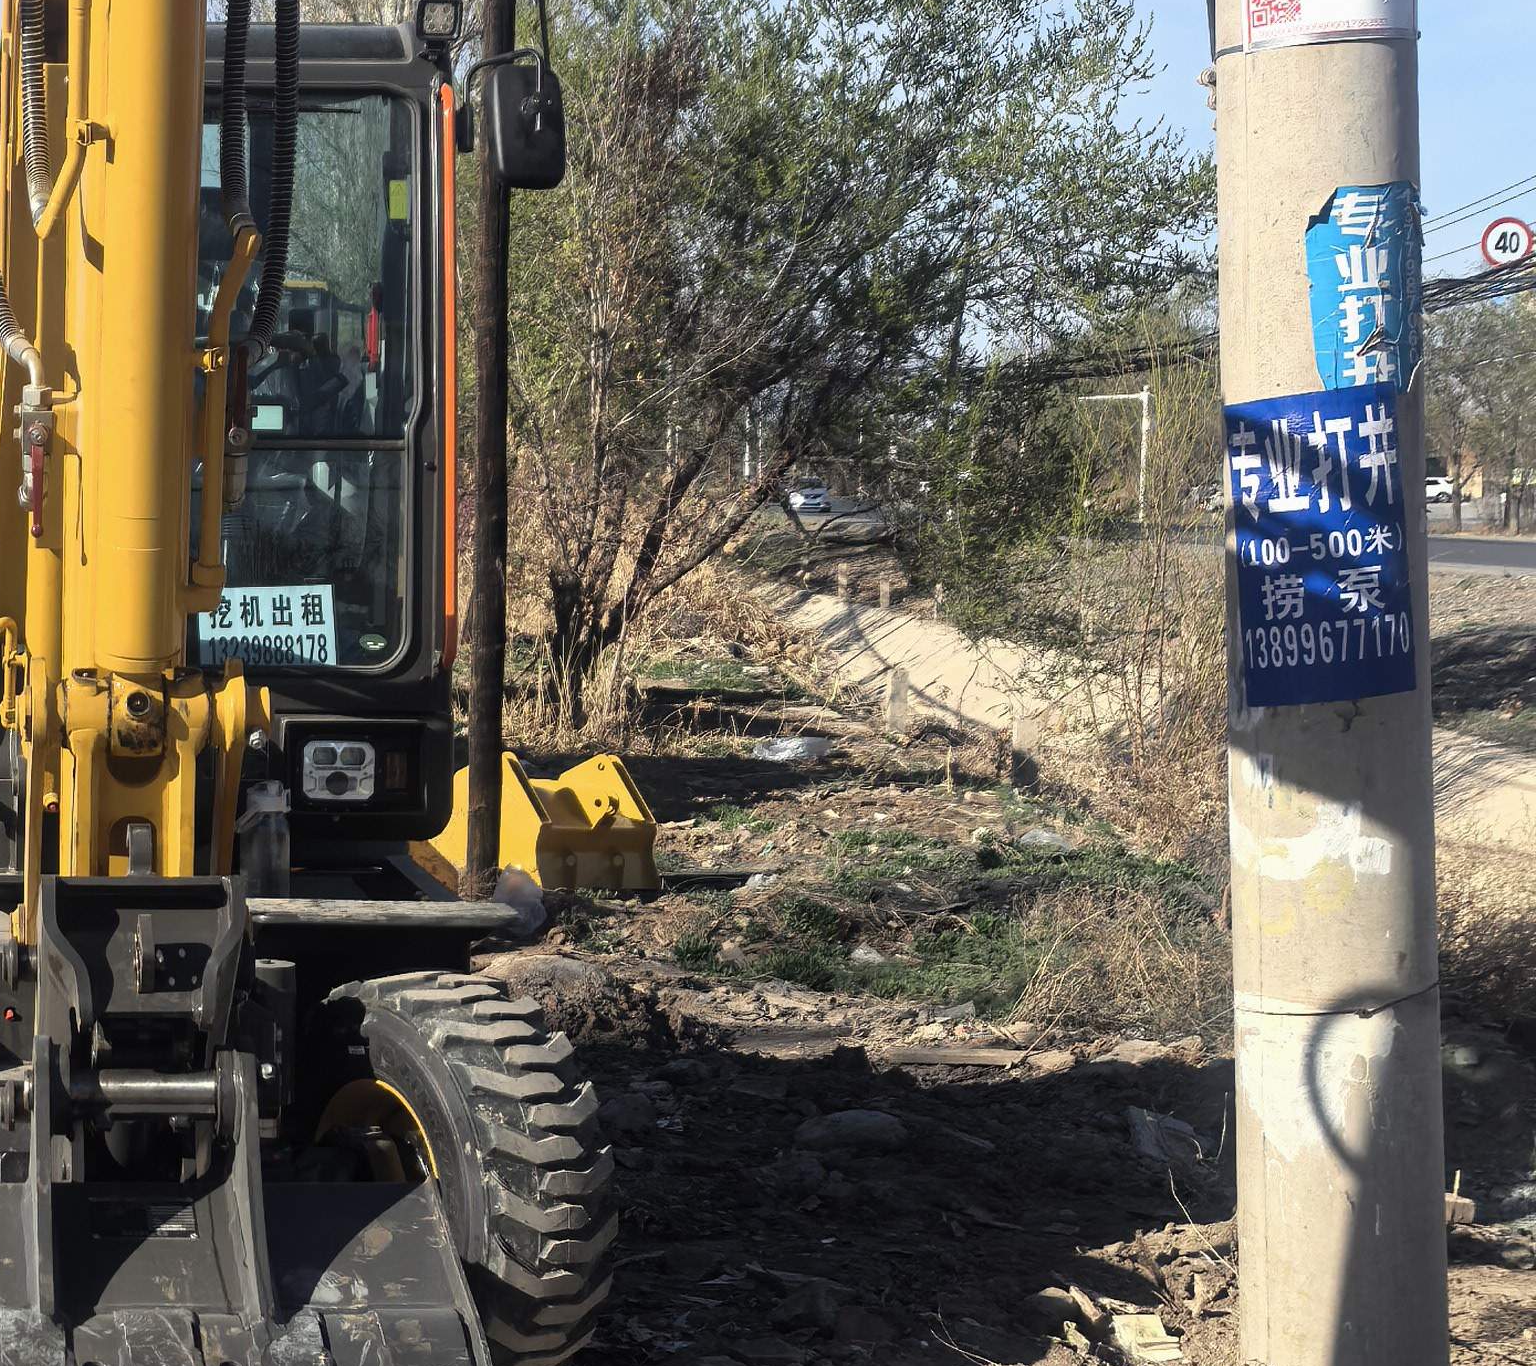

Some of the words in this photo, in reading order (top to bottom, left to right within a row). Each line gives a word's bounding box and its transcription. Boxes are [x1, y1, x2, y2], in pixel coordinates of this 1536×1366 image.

[1494, 231, 1520, 253] 40
[1228, 403, 1398, 521] 专业打井
[209, 593, 326, 628] 挖机出租
[1245, 611, 1412, 670] 13899677170
